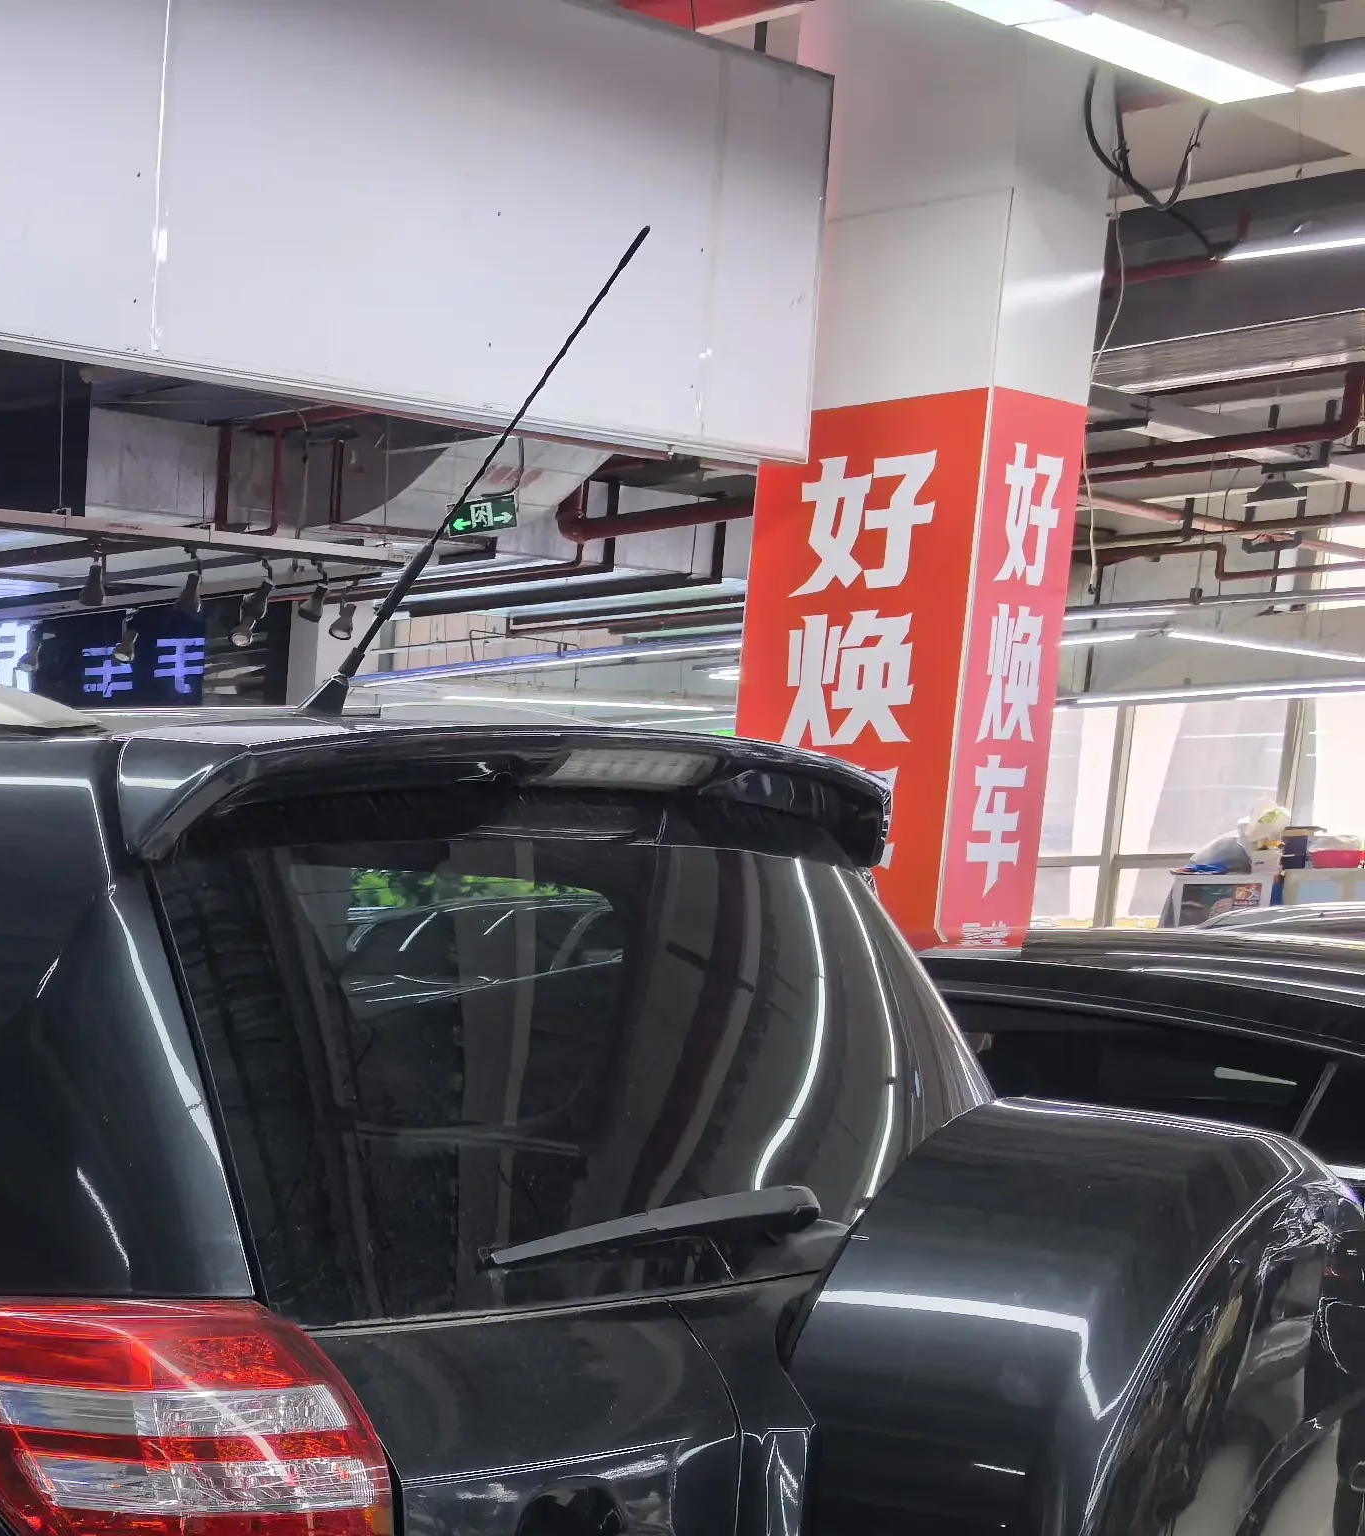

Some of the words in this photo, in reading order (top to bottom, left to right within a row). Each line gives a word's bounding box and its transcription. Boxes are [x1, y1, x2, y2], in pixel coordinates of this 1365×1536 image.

[780, 449, 938, 868] 好焕
[966, 441, 1064, 898] 好焕车
